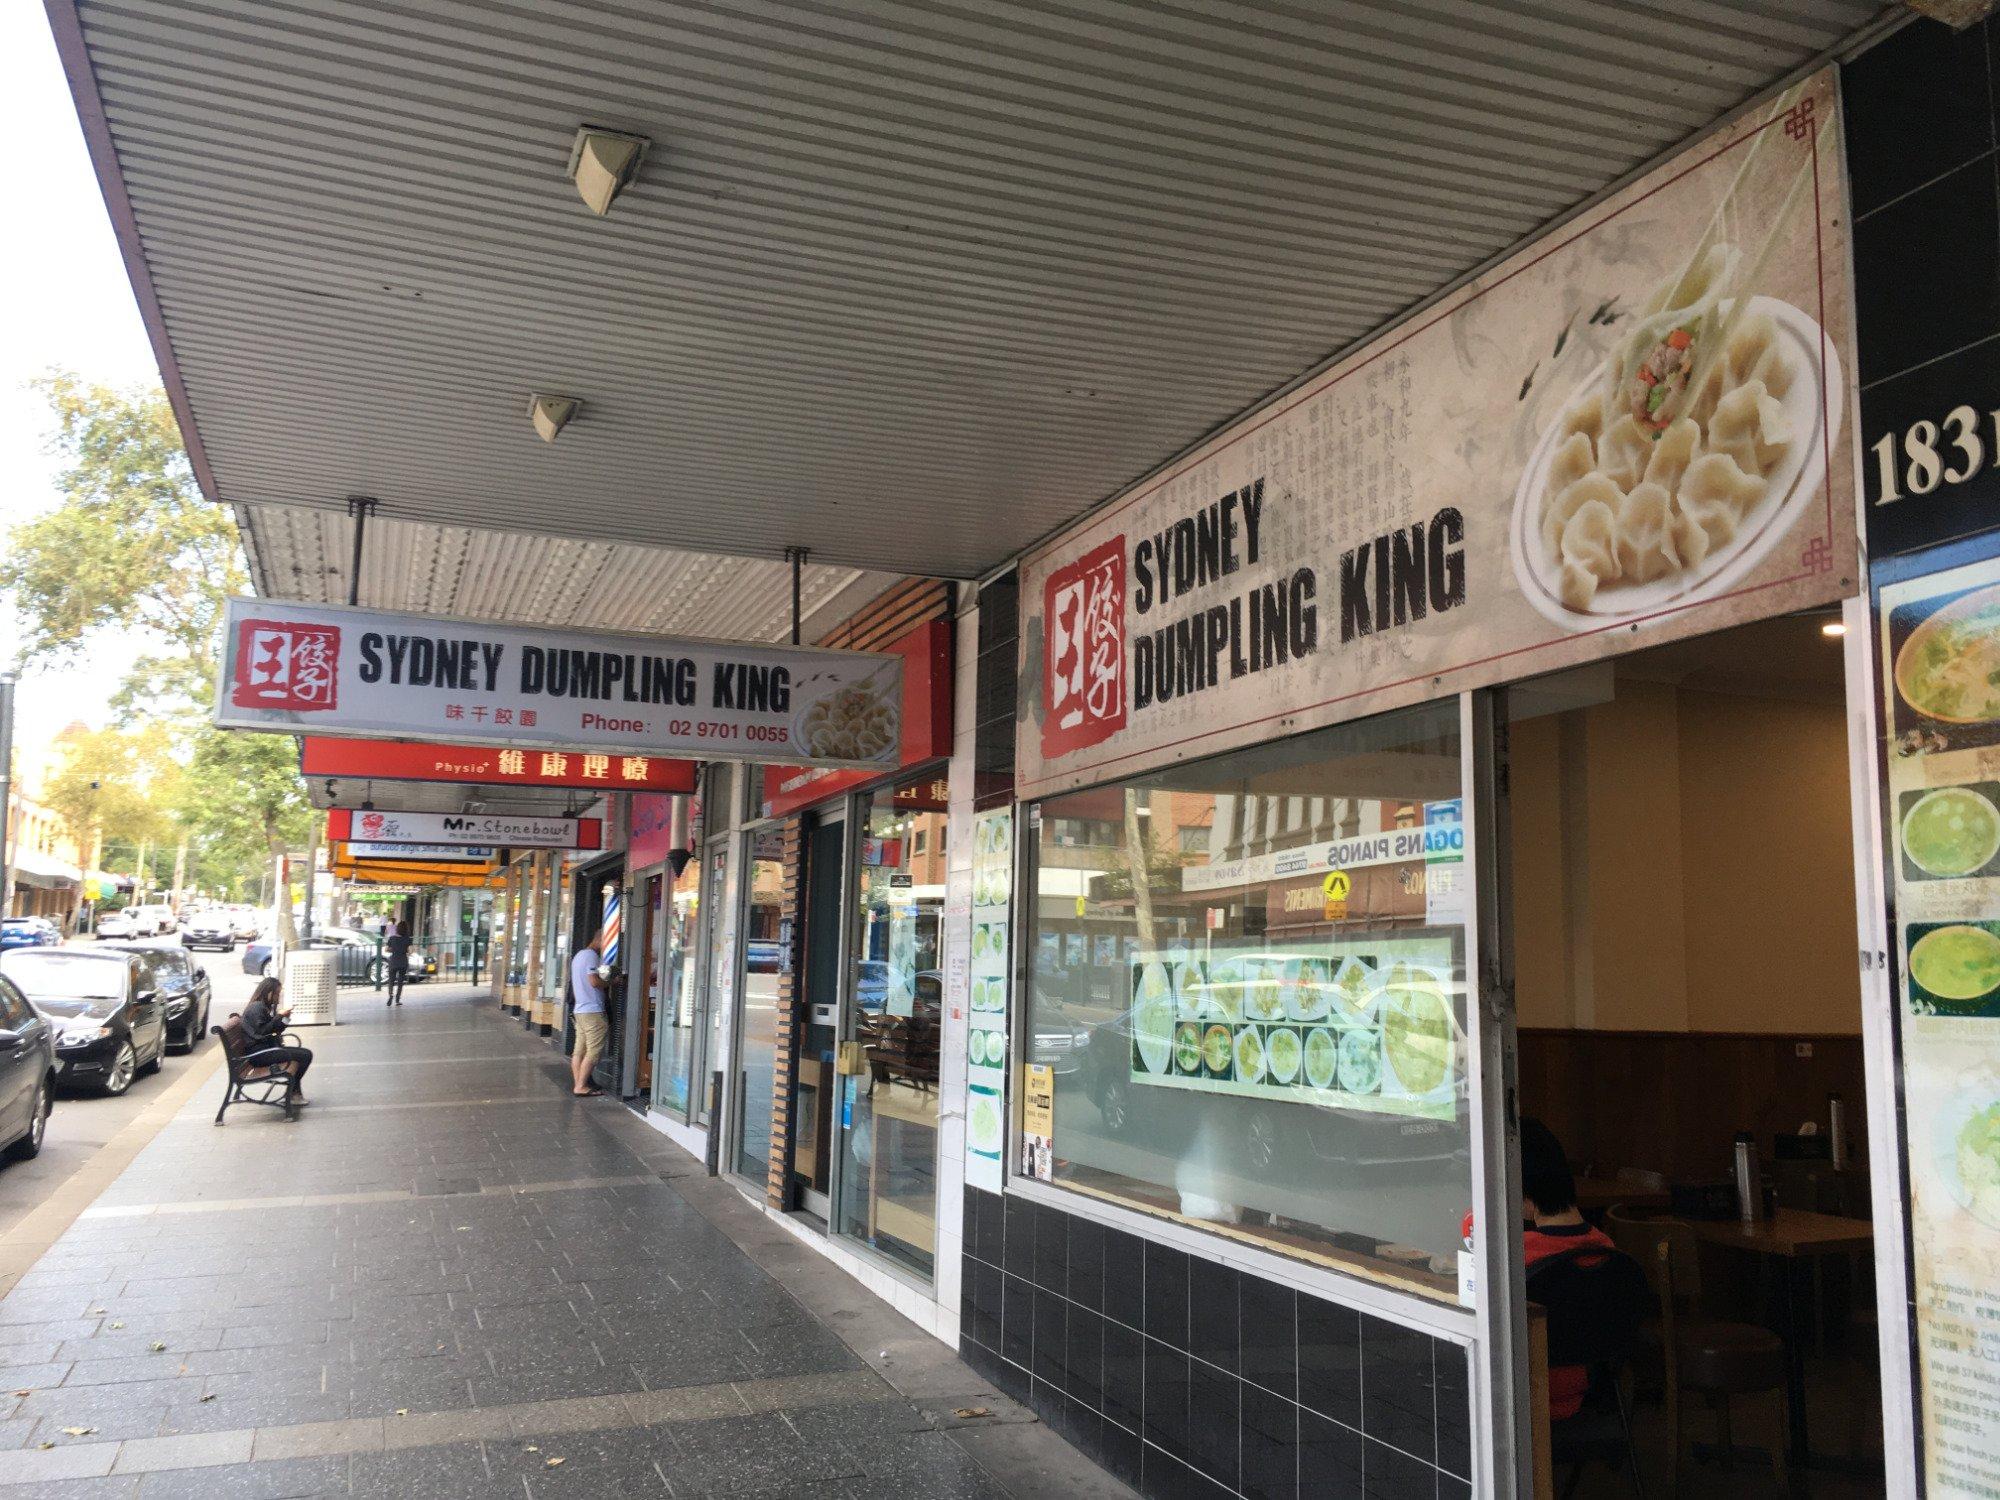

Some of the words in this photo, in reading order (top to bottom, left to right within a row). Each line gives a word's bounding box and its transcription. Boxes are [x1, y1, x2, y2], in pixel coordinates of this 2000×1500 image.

[1870, 404, 2000, 508] 183
[1134, 476, 1266, 616] SYDNEY
[1134, 567, 1318, 711] DUMPLING
[1339, 506, 1467, 644] KING
[359, 631, 505, 692] SYDNEY
[520, 645, 697, 705] DUMPLING
[713, 663, 791, 713] KING
[581, 712, 651, 734] Phone:
[669, 719, 691, 737] 02
[697, 722, 739, 740] 9701
[745, 724, 788, 743] 0055
